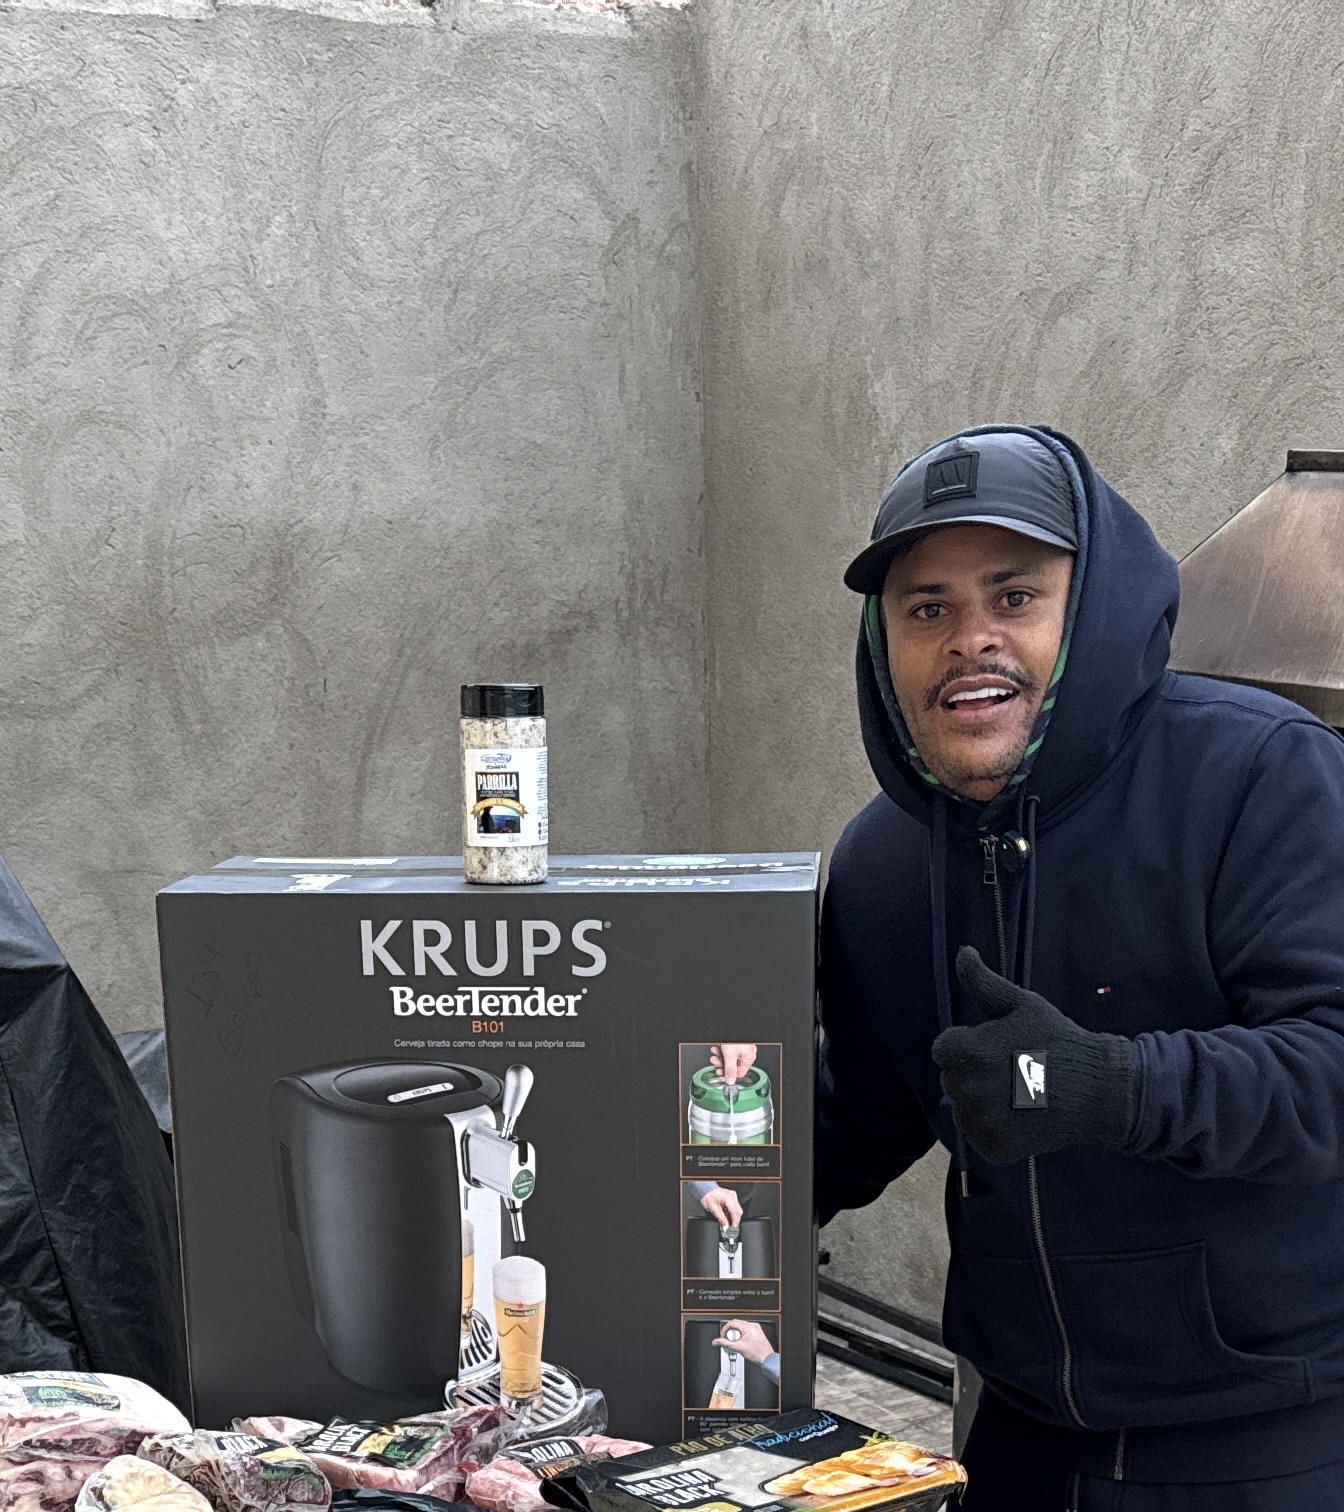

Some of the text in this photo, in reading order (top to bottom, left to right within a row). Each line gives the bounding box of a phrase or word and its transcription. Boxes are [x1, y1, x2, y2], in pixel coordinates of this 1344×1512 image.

[360, 919, 607, 978] KRUPS
[389, 986, 582, 1018] BeerTender
[471, 1020, 505, 1034] B101
[394, 1039, 425, 1049] Cerveja
[452, 1040, 476, 1048] como
